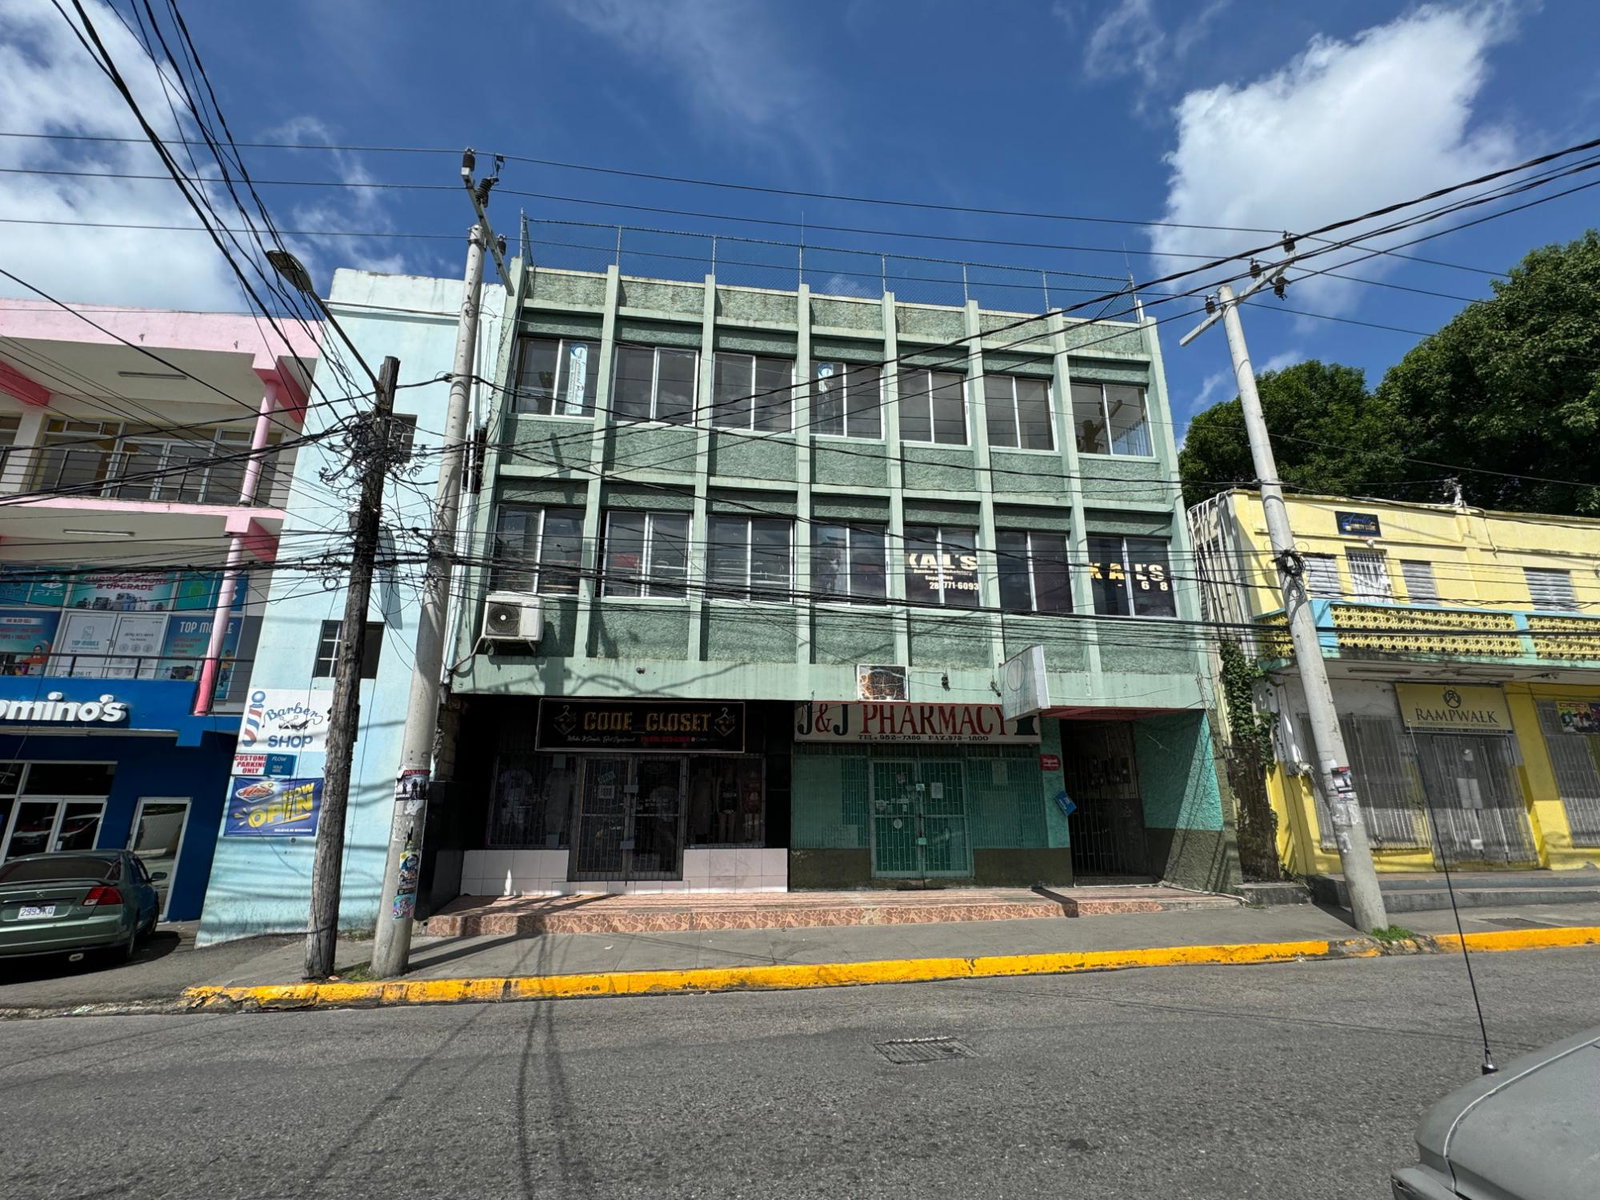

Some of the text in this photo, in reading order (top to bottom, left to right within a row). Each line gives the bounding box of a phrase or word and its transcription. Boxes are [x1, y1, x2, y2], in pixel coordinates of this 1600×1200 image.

[106, 583, 154, 591] UPGRADE
[180, 621, 197, 633] TOP
[0, 690, 128, 722] mino's
[264, 702, 322, 721] Barber
[584, 712, 712, 732] CODE CLOSET
[797, 702, 1007, 736] J&J PHARMACY
[1415, 708, 1498, 723] RAMPWALK
[268, 735, 314, 748] SHOP
[282, 783, 315, 798] NOW
[248, 793, 314, 828] OPEN
